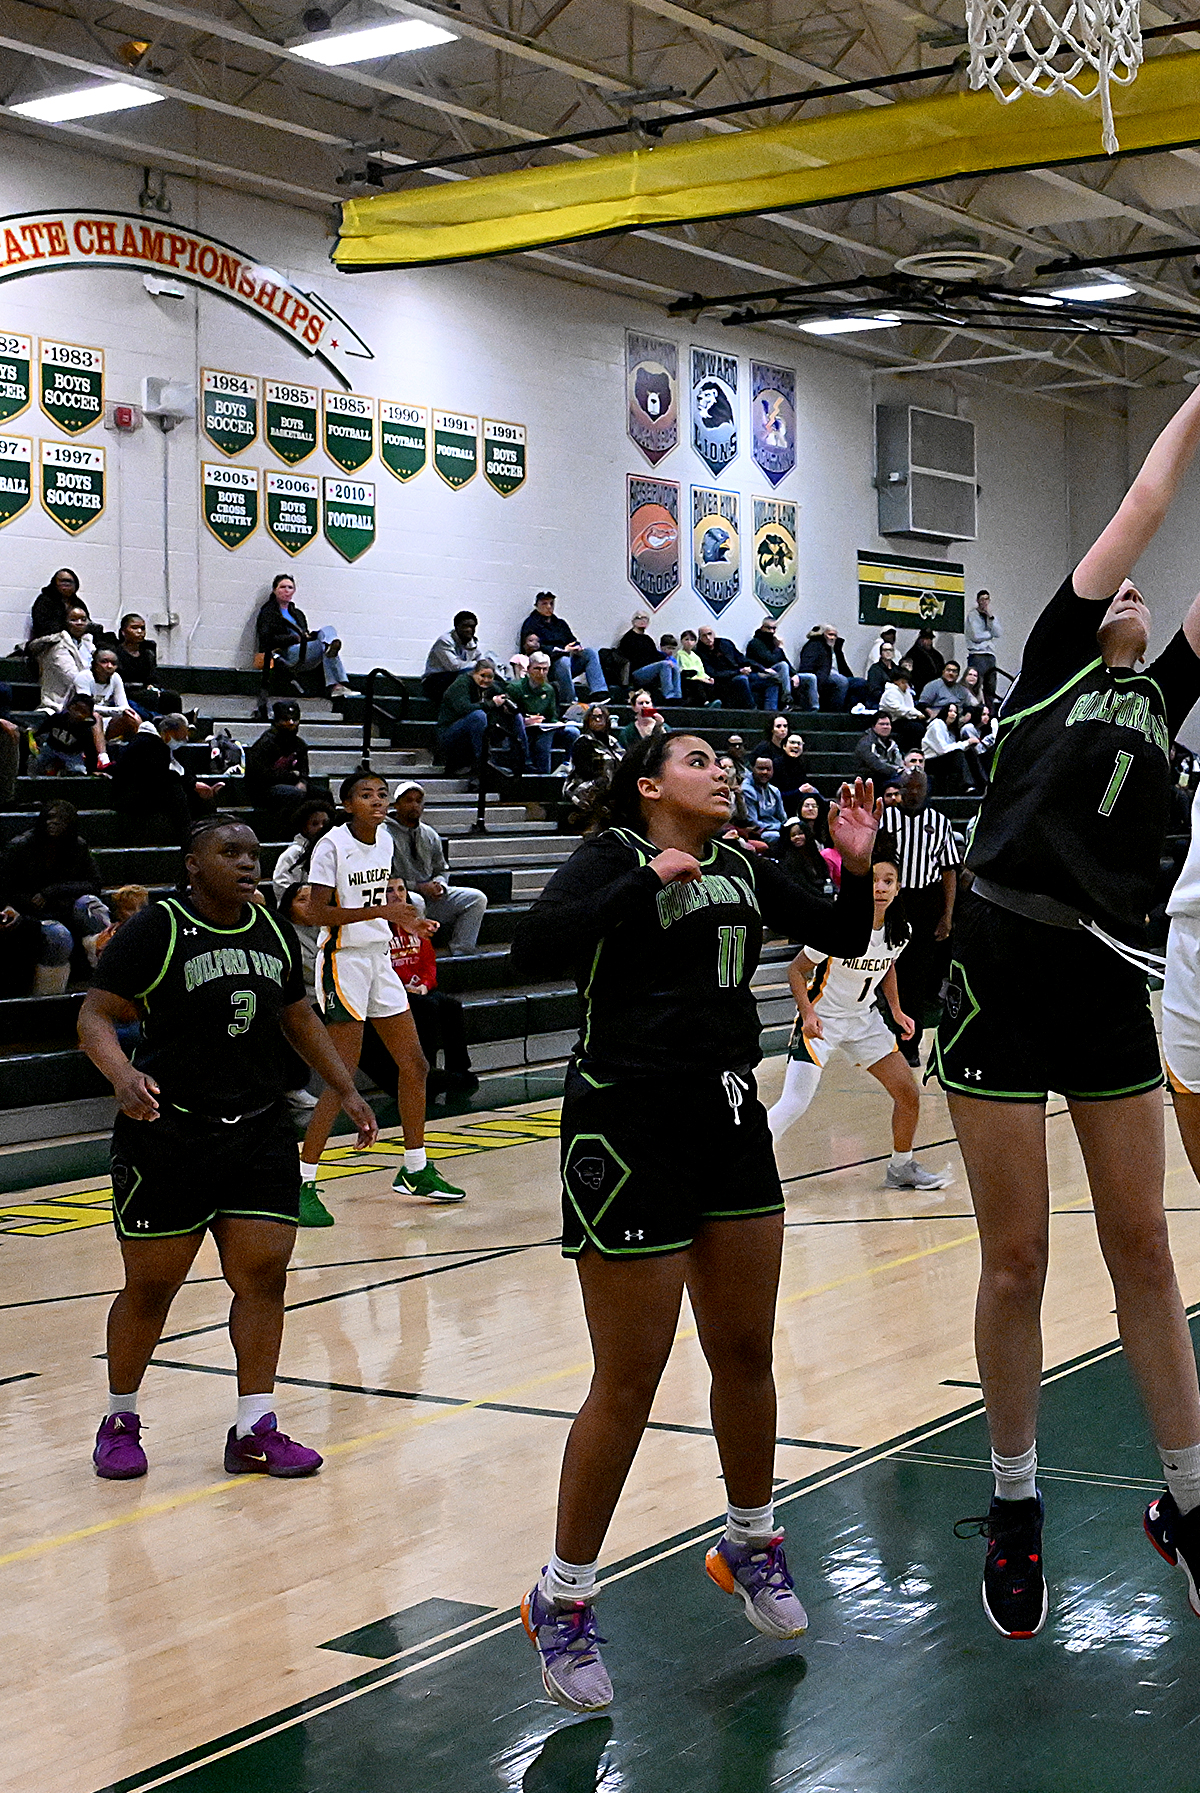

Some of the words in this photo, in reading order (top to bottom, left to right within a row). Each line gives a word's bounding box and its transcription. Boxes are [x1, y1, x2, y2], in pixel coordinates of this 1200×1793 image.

[0, 219, 71, 268] ATE
[73, 219, 326, 346] CHAMPIONSHIPS
[51, 346, 93, 367] 1983
[53, 372, 91, 393] BOYS
[212, 375, 249, 394] 1984
[44, 389, 100, 412] SOCCER
[274, 386, 310, 405] 1985
[215, 400, 247, 418] BOYS
[332, 396, 366, 415] 1985
[280, 416, 305, 431] BOYS
[388, 406, 419, 424] 1990
[442, 417, 469, 431] 1991
[206, 415, 255, 436] SOCCER
[270, 427, 315, 442] BASKETBALL
[327, 424, 372, 442] FOOTBALL
[492, 426, 518, 440] 1991
[383, 433, 426, 451] FOOTBALL
[693, 421, 738, 464] LIONS
[54, 448, 92, 465] 1997
[436, 444, 475, 461] FOOTBALL
[492, 447, 518, 463] BOYS
[213, 470, 249, 486] 2005
[486, 461, 524, 479] SOCCER
[55, 471, 92, 491] BOYS
[276, 478, 311, 494] 2006
[46, 488, 102, 510] SOCCER
[217, 490, 246, 505] BOYS
[335, 484, 365, 501] 2010
[216, 502, 247, 515] CROSS
[280, 500, 307, 514] BOYS
[209, 512, 254, 527] COUNTRY
[278, 512, 308, 524] CROSS
[327, 510, 374, 531] FOOTBALL
[273, 521, 314, 536] COUNTRY
[1098, 750, 1134, 817] 1
[718, 925, 747, 988] 11
[842, 957, 894, 972] WILDECAT
[856, 976, 874, 1003] 1
[227, 990, 257, 1038] 3
